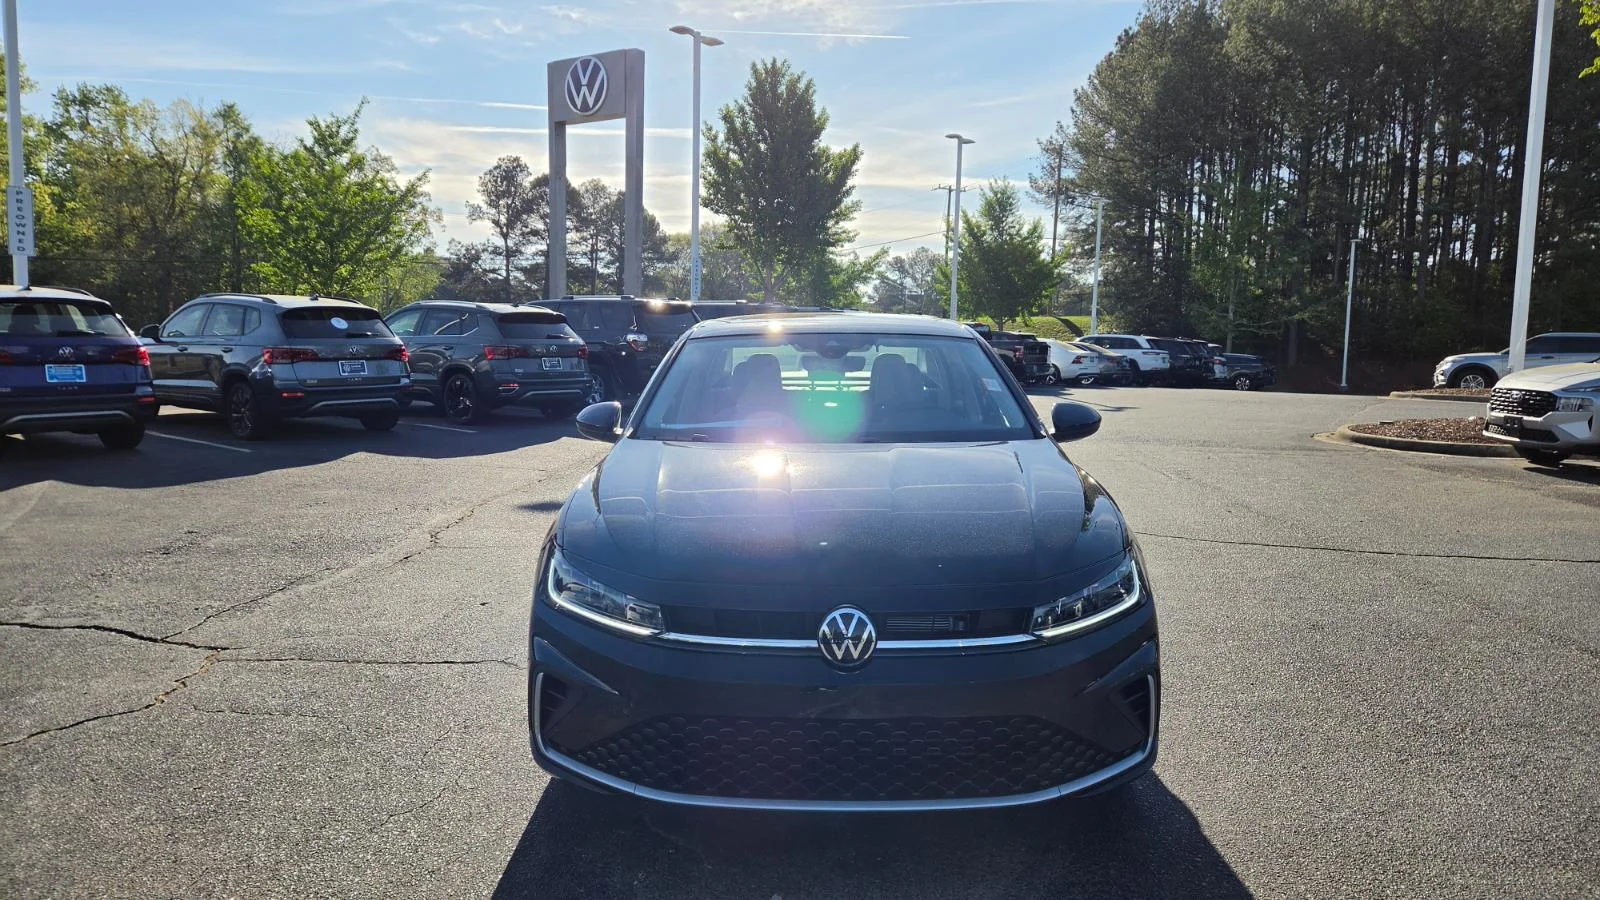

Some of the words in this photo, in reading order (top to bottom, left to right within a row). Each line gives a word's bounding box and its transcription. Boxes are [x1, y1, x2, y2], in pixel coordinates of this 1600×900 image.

[567, 57, 605, 111] VW
[15, 189, 26, 252] PREOWNED
[820, 610, 875, 662] VW
